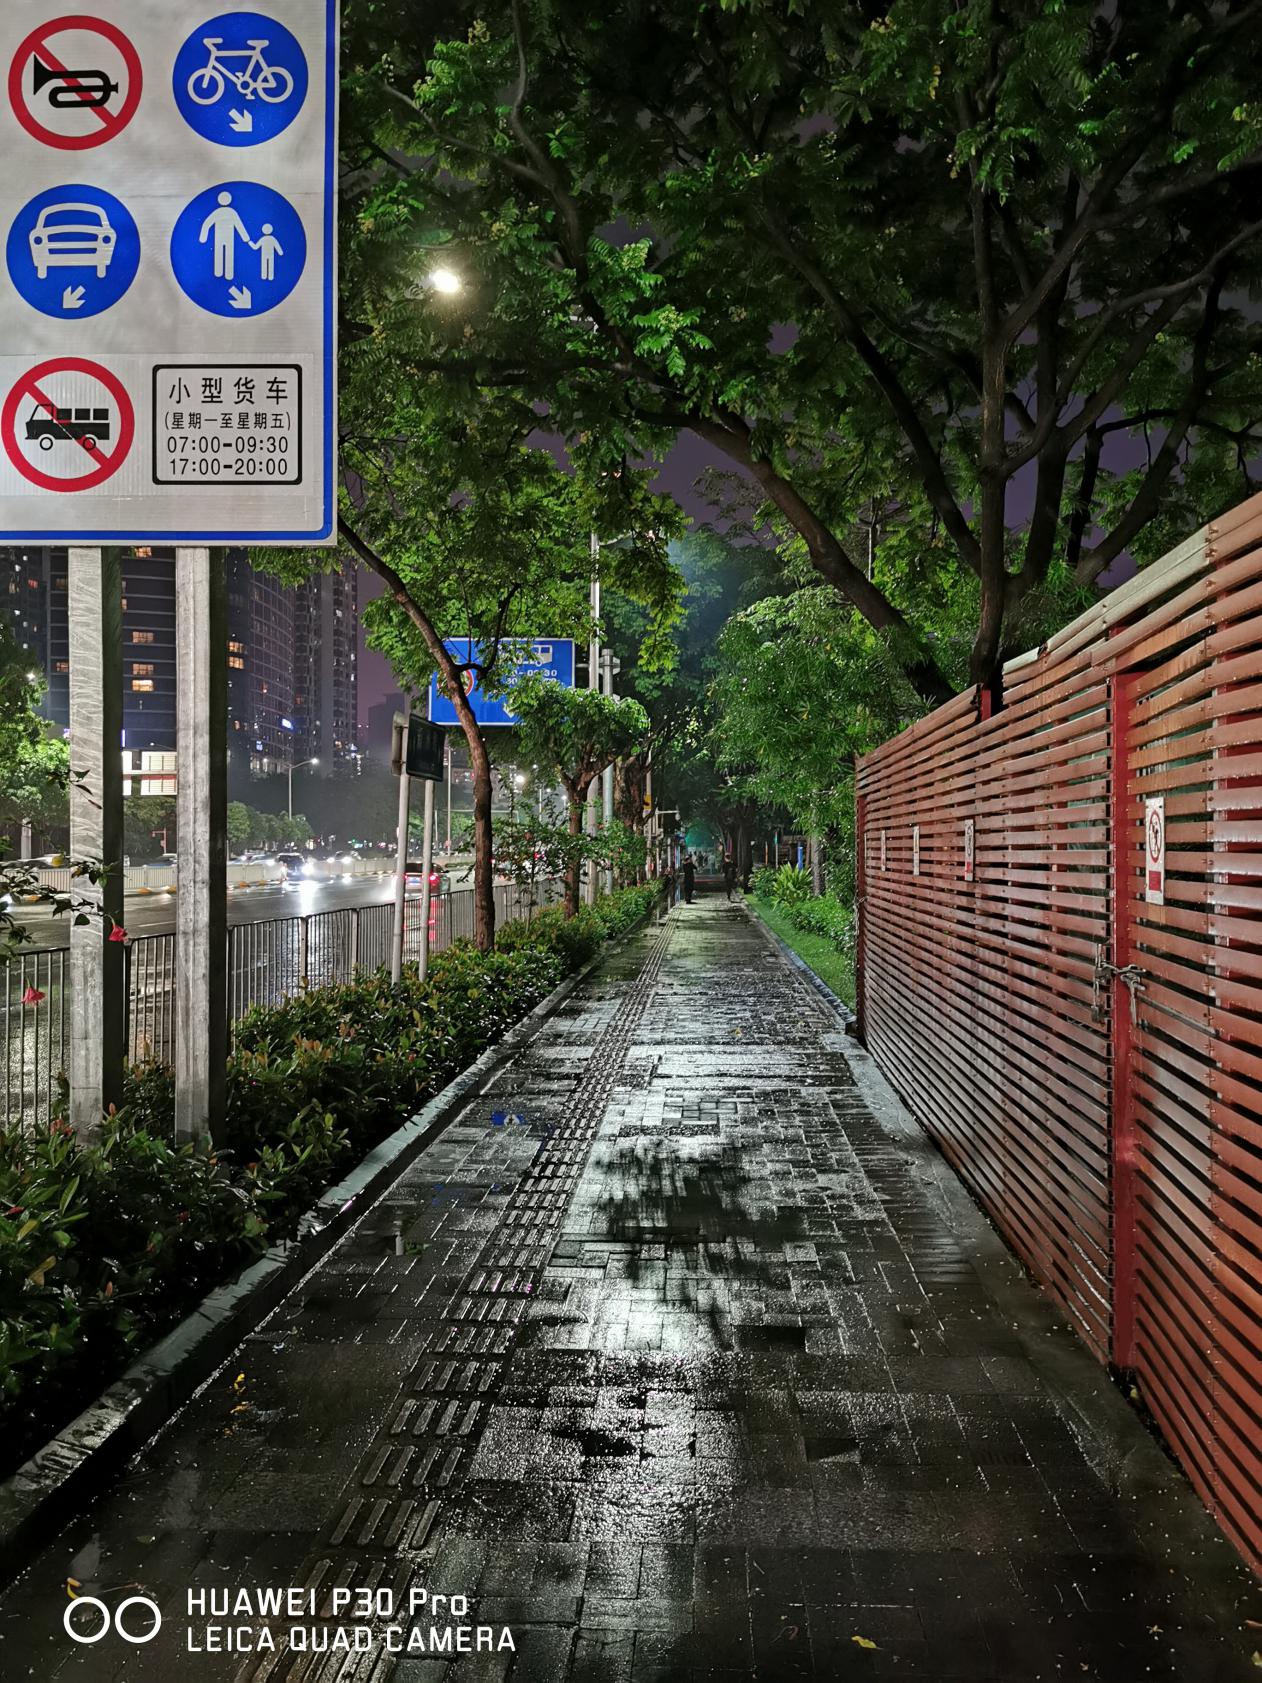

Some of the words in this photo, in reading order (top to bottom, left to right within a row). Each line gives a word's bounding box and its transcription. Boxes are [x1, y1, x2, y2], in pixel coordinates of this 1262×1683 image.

[169, 376, 288, 405] 小型货车
[164, 411, 291, 431] (星期一至星期五)
[167, 436, 288, 453] 07:00-09:30
[169, 458, 288, 475] 17:00-20:00
